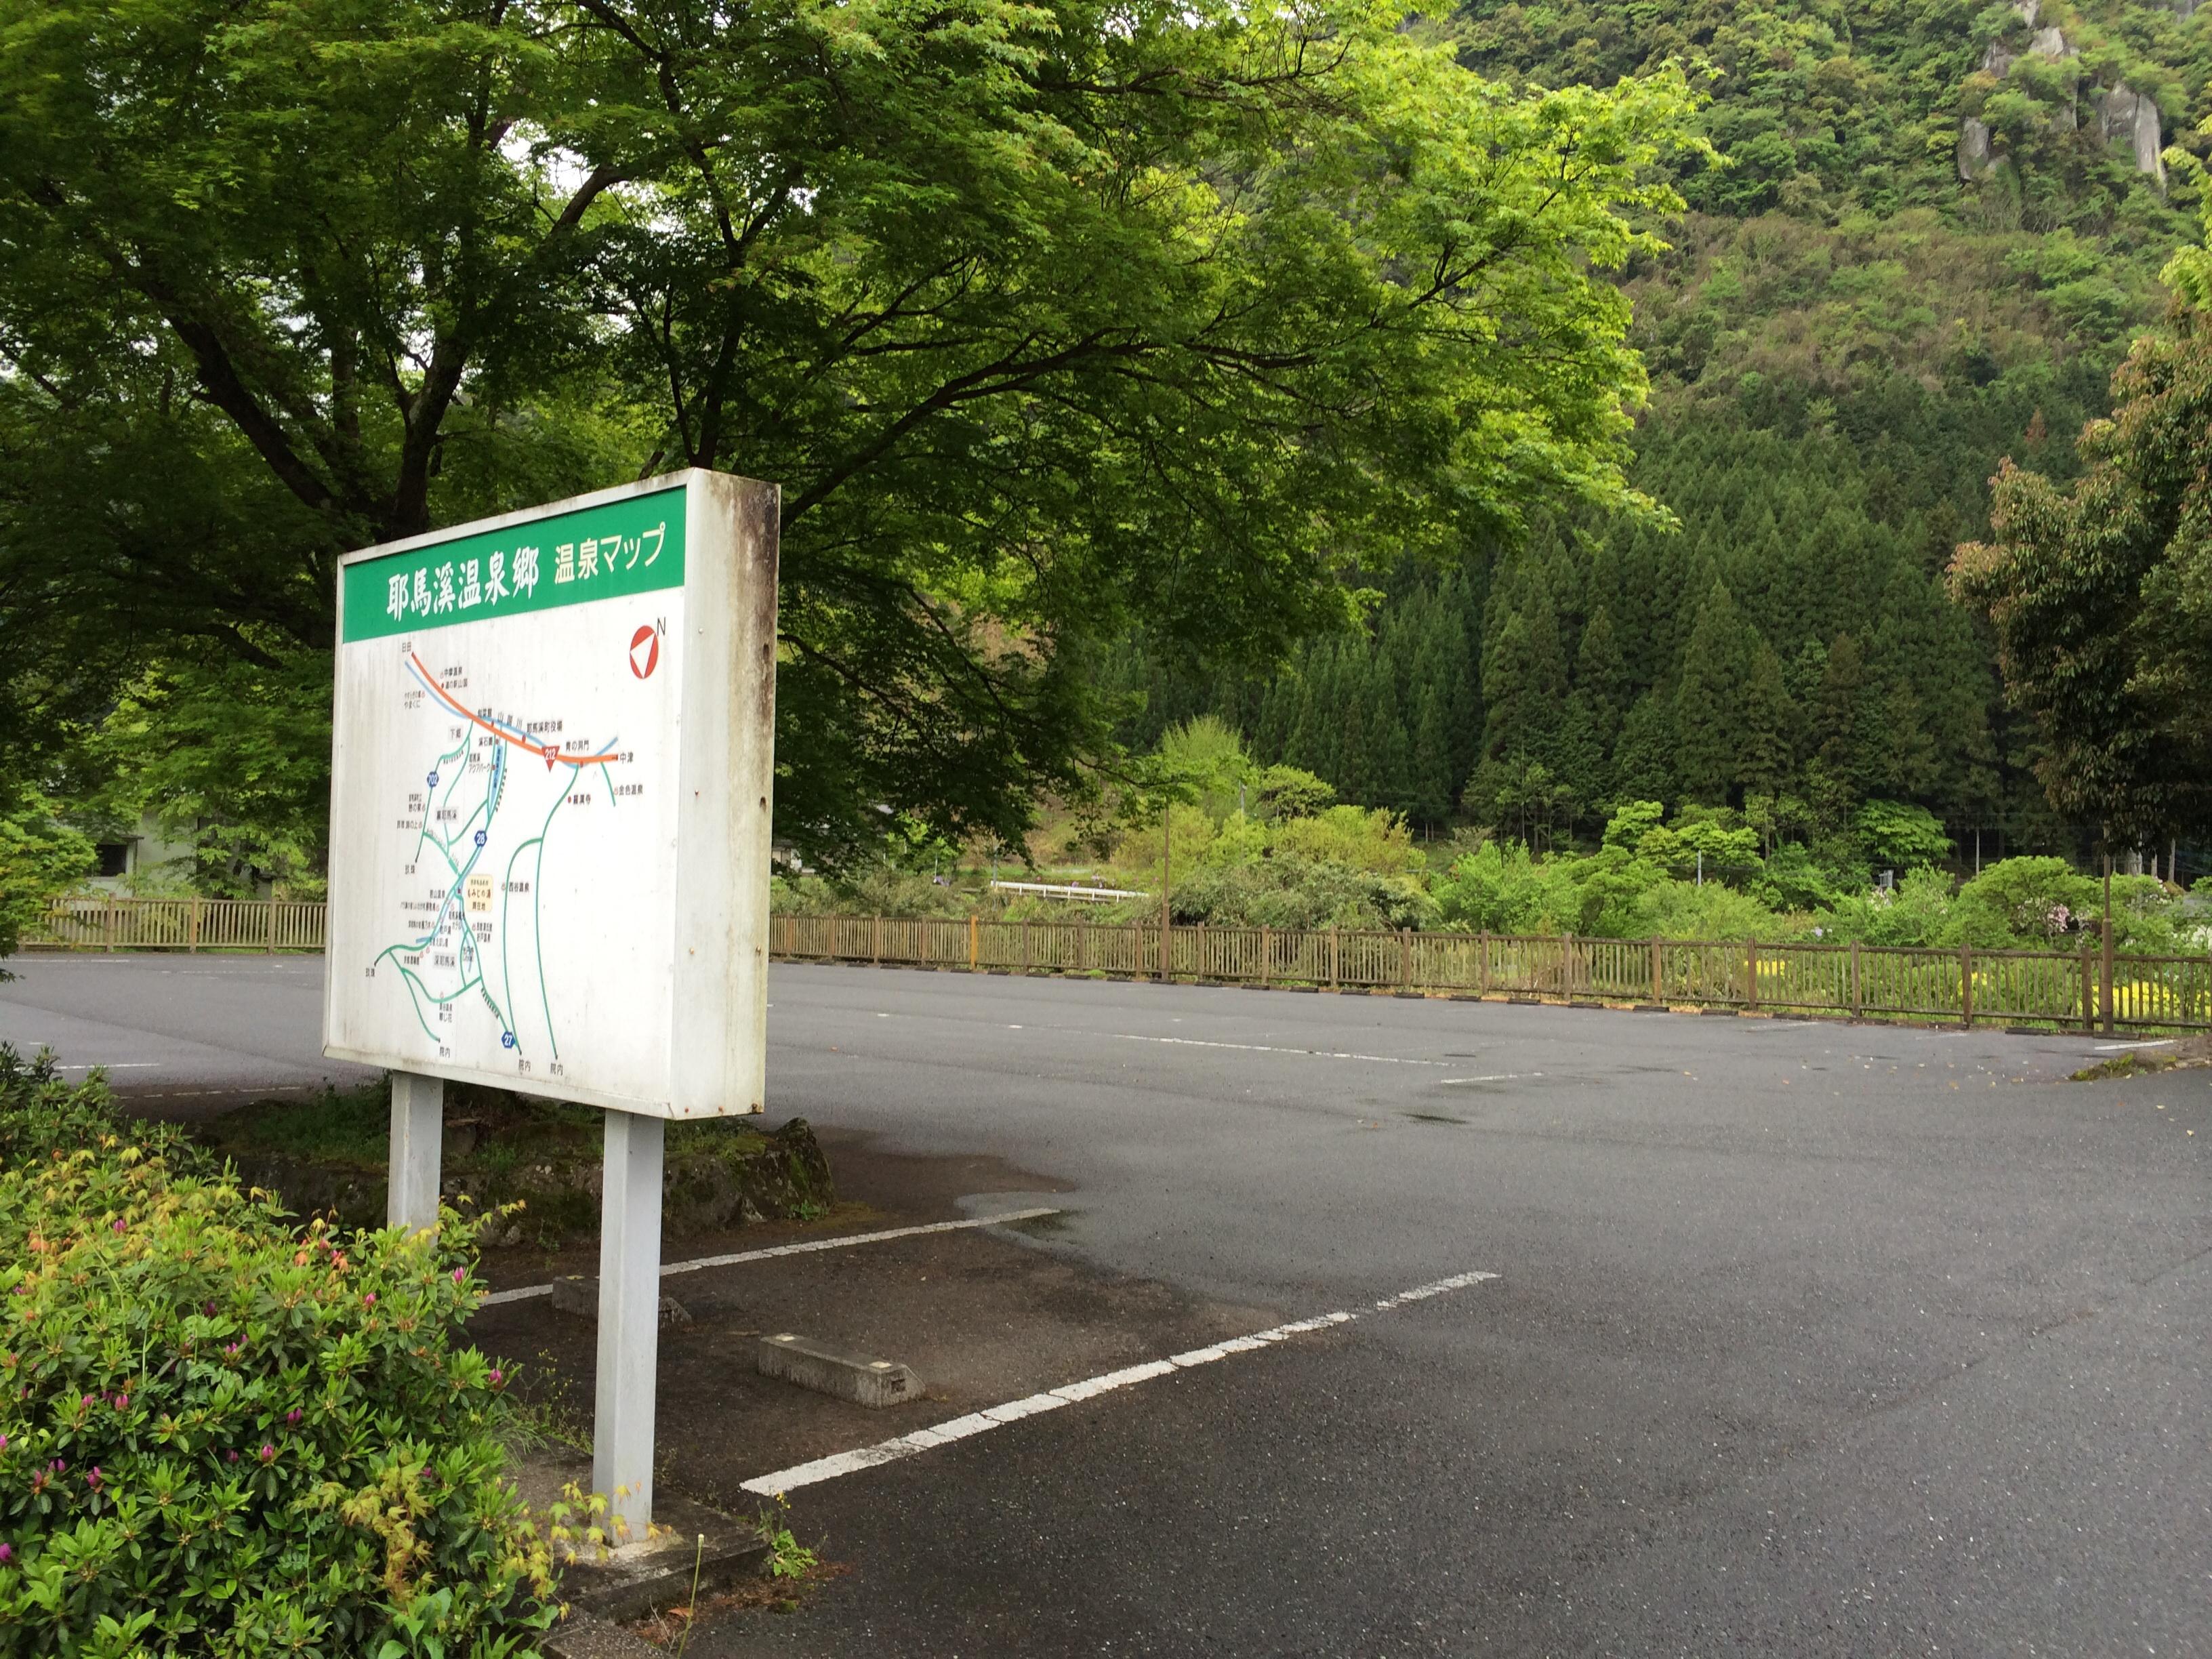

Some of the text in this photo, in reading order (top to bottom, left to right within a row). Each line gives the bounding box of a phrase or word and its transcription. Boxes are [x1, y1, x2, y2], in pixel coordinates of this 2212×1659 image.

[554, 521, 666, 584] 温泉マップ
[657, 617, 666, 637] N
[402, 642, 412, 653] 日田
[544, 747, 556, 760] 212
[619, 752, 634, 764] 中津
[476, 833, 486, 844] 28
[468, 888, 491, 899] もみじの湯
[508, 882, 529, 893] 西谷温泉
[504, 1035, 513, 1047] 27
[439, 1046, 451, 1059] 院内
[518, 1059, 531, 1072] 院内
[550, 1063, 564, 1075] 院内
